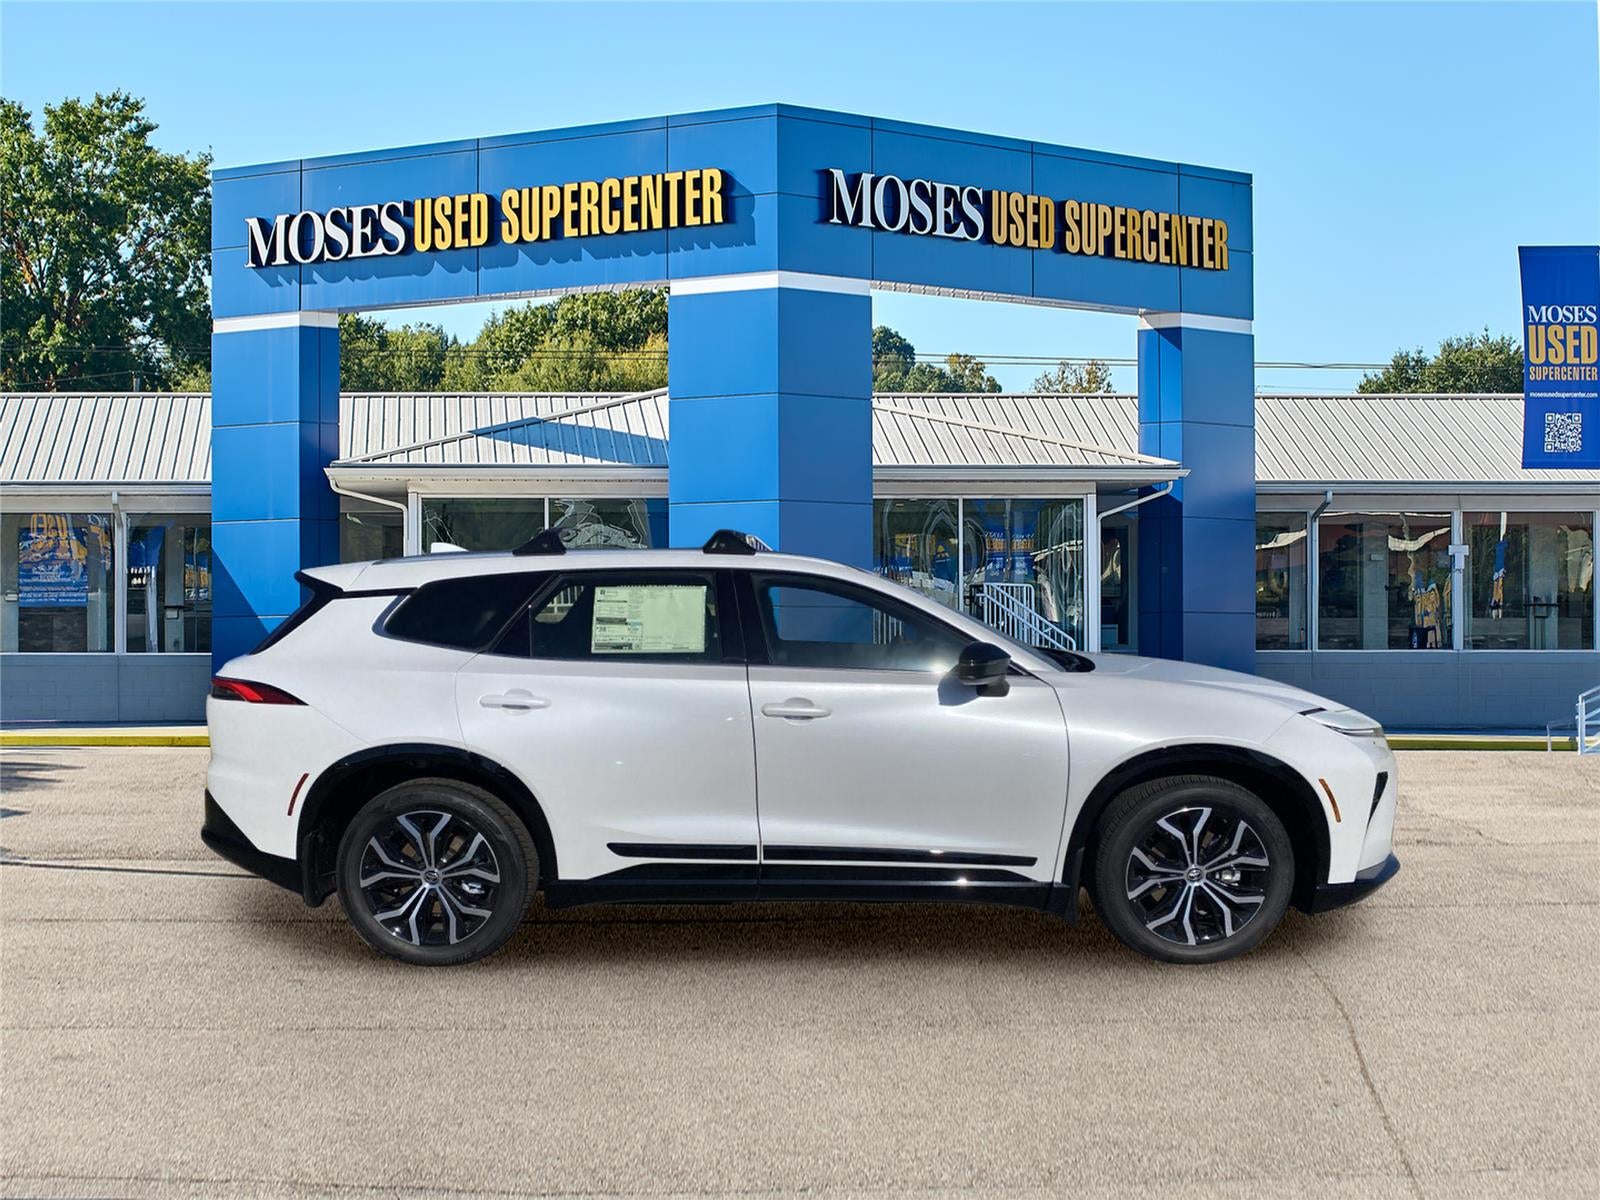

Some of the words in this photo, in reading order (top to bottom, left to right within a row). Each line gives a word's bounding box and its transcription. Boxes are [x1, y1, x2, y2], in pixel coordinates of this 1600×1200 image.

[244, 201, 405, 268] MOSES
[413, 193, 488, 252] USED
[501, 168, 724, 245] SUPERCENTER
[829, 168, 984, 241] MOSES
[991, 190, 1056, 249] USED
[1065, 200, 1230, 270] SUPERCENTER
[1527, 305, 1597, 324] MOSES
[1528, 325, 1598, 364] USED
[1529, 366, 1598, 381] SUPERCENTER
